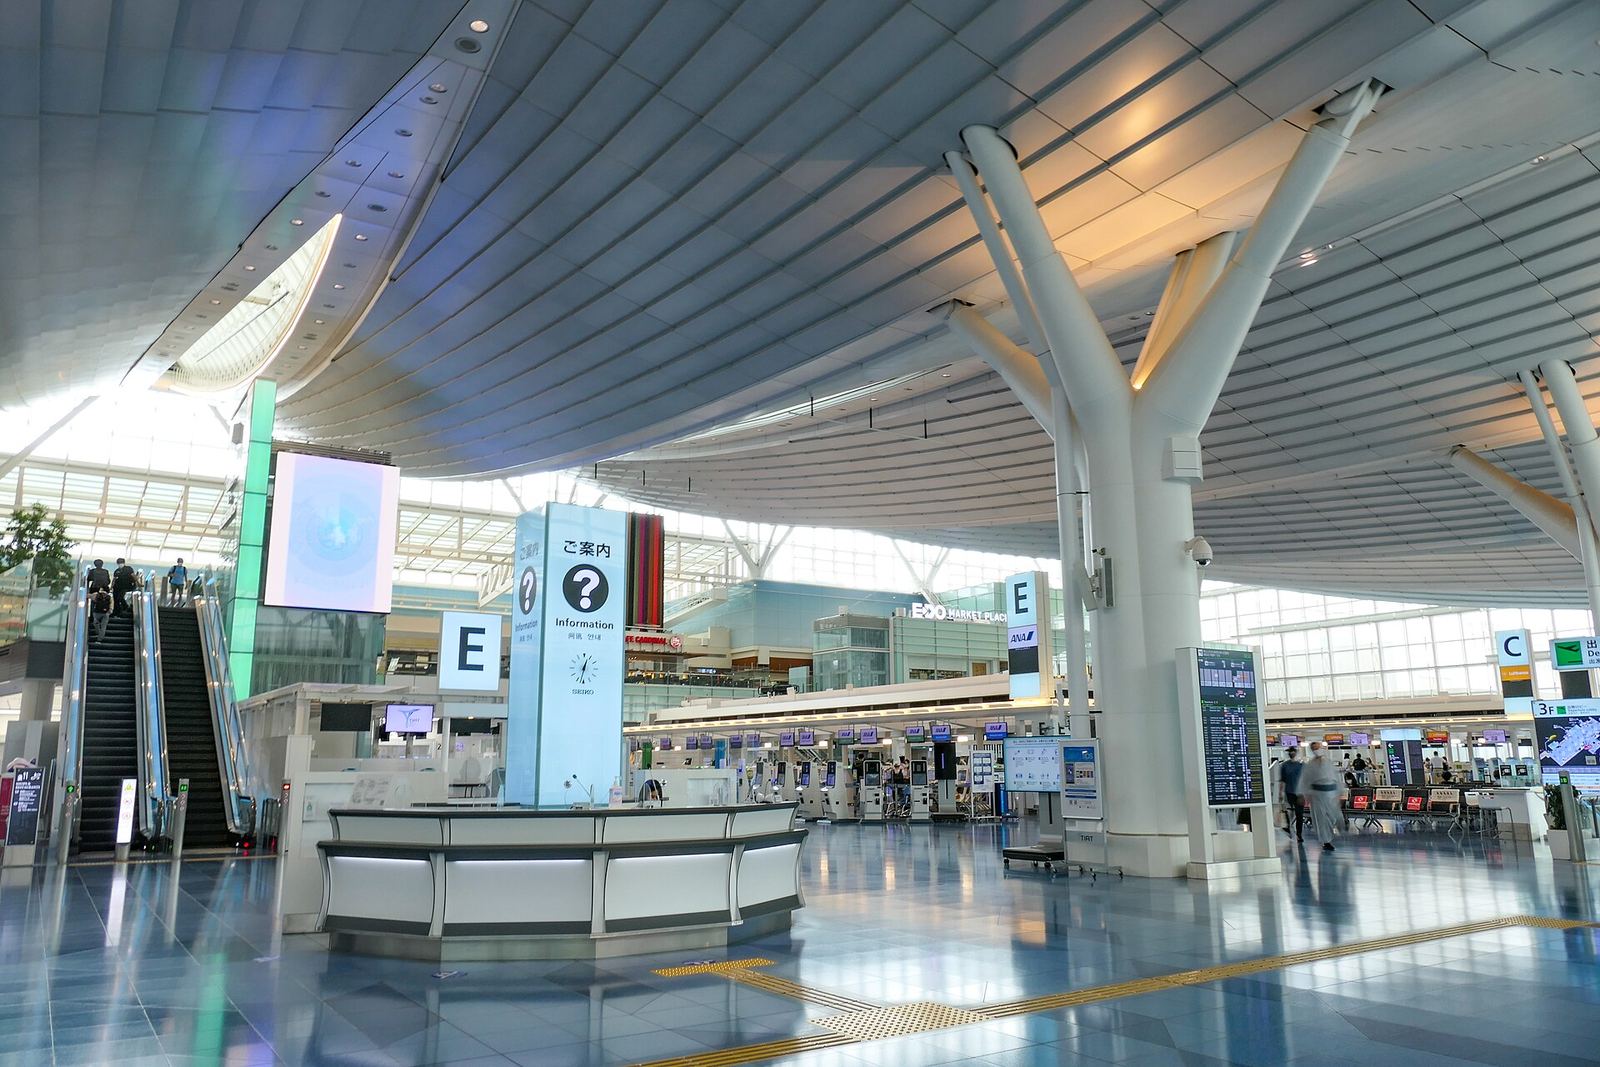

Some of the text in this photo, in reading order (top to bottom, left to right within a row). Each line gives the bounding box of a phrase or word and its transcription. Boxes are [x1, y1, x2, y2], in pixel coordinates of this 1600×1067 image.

[564, 540, 611, 558] ご案内
[1013, 582, 1029, 614] E
[555, 617, 614, 630] Information
[948, 608, 982, 621] MARKET
[1010, 634, 1025, 643] ANA
[1503, 636, 1522, 657] C
[458, 626, 485, 671] E
